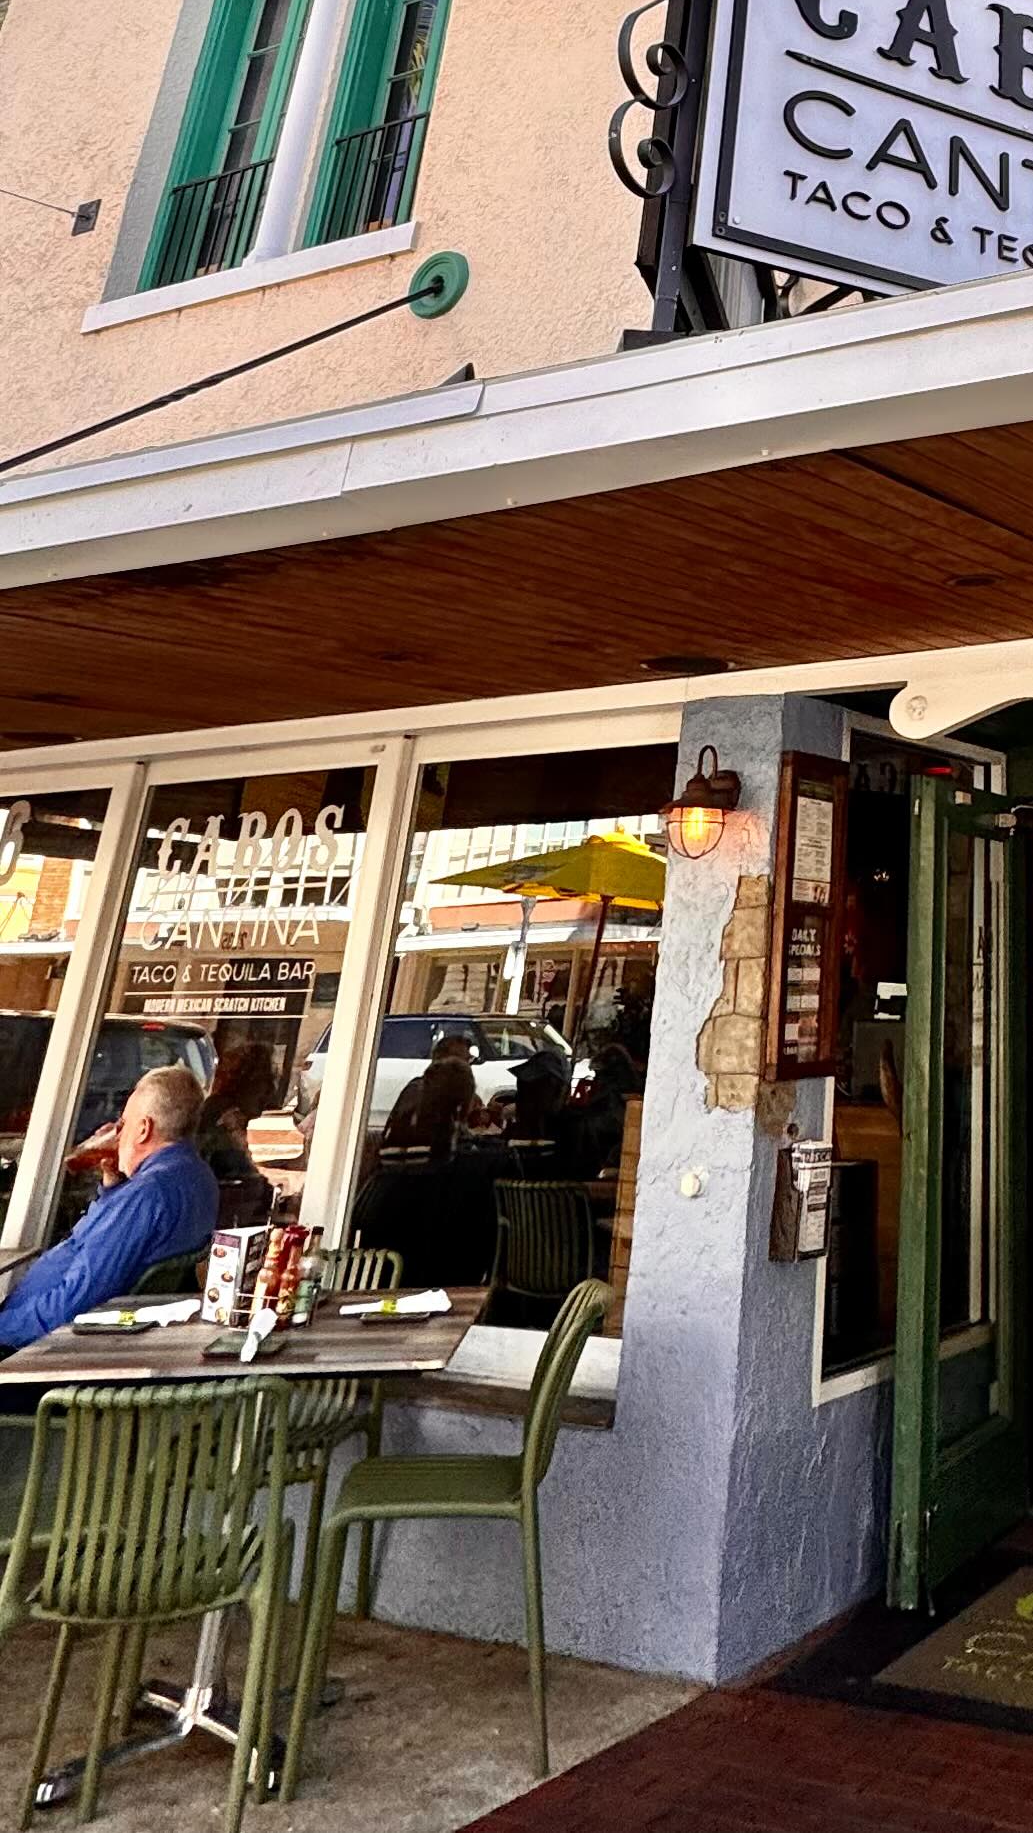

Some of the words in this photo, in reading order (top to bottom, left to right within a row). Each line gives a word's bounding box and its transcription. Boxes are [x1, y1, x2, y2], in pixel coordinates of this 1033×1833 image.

[782, 169, 911, 231] TACO
[930, 216, 954, 245] &
[157, 804, 346, 879] CABOS
[139, 902, 320, 951] CANTINA
[792, 928, 817, 942] DAILY
[132, 964, 177, 983] TACO
[181, 965, 192, 983] &
[200, 962, 271, 983] TEQUILA
[277, 961, 316, 981] BAR
[143, 999, 174, 1012] MODERN
[175, 998, 213, 1012] MEXICAN
[213, 998, 249, 1012] SCRATCH
[250, 997, 287, 1011] KITCHEN
